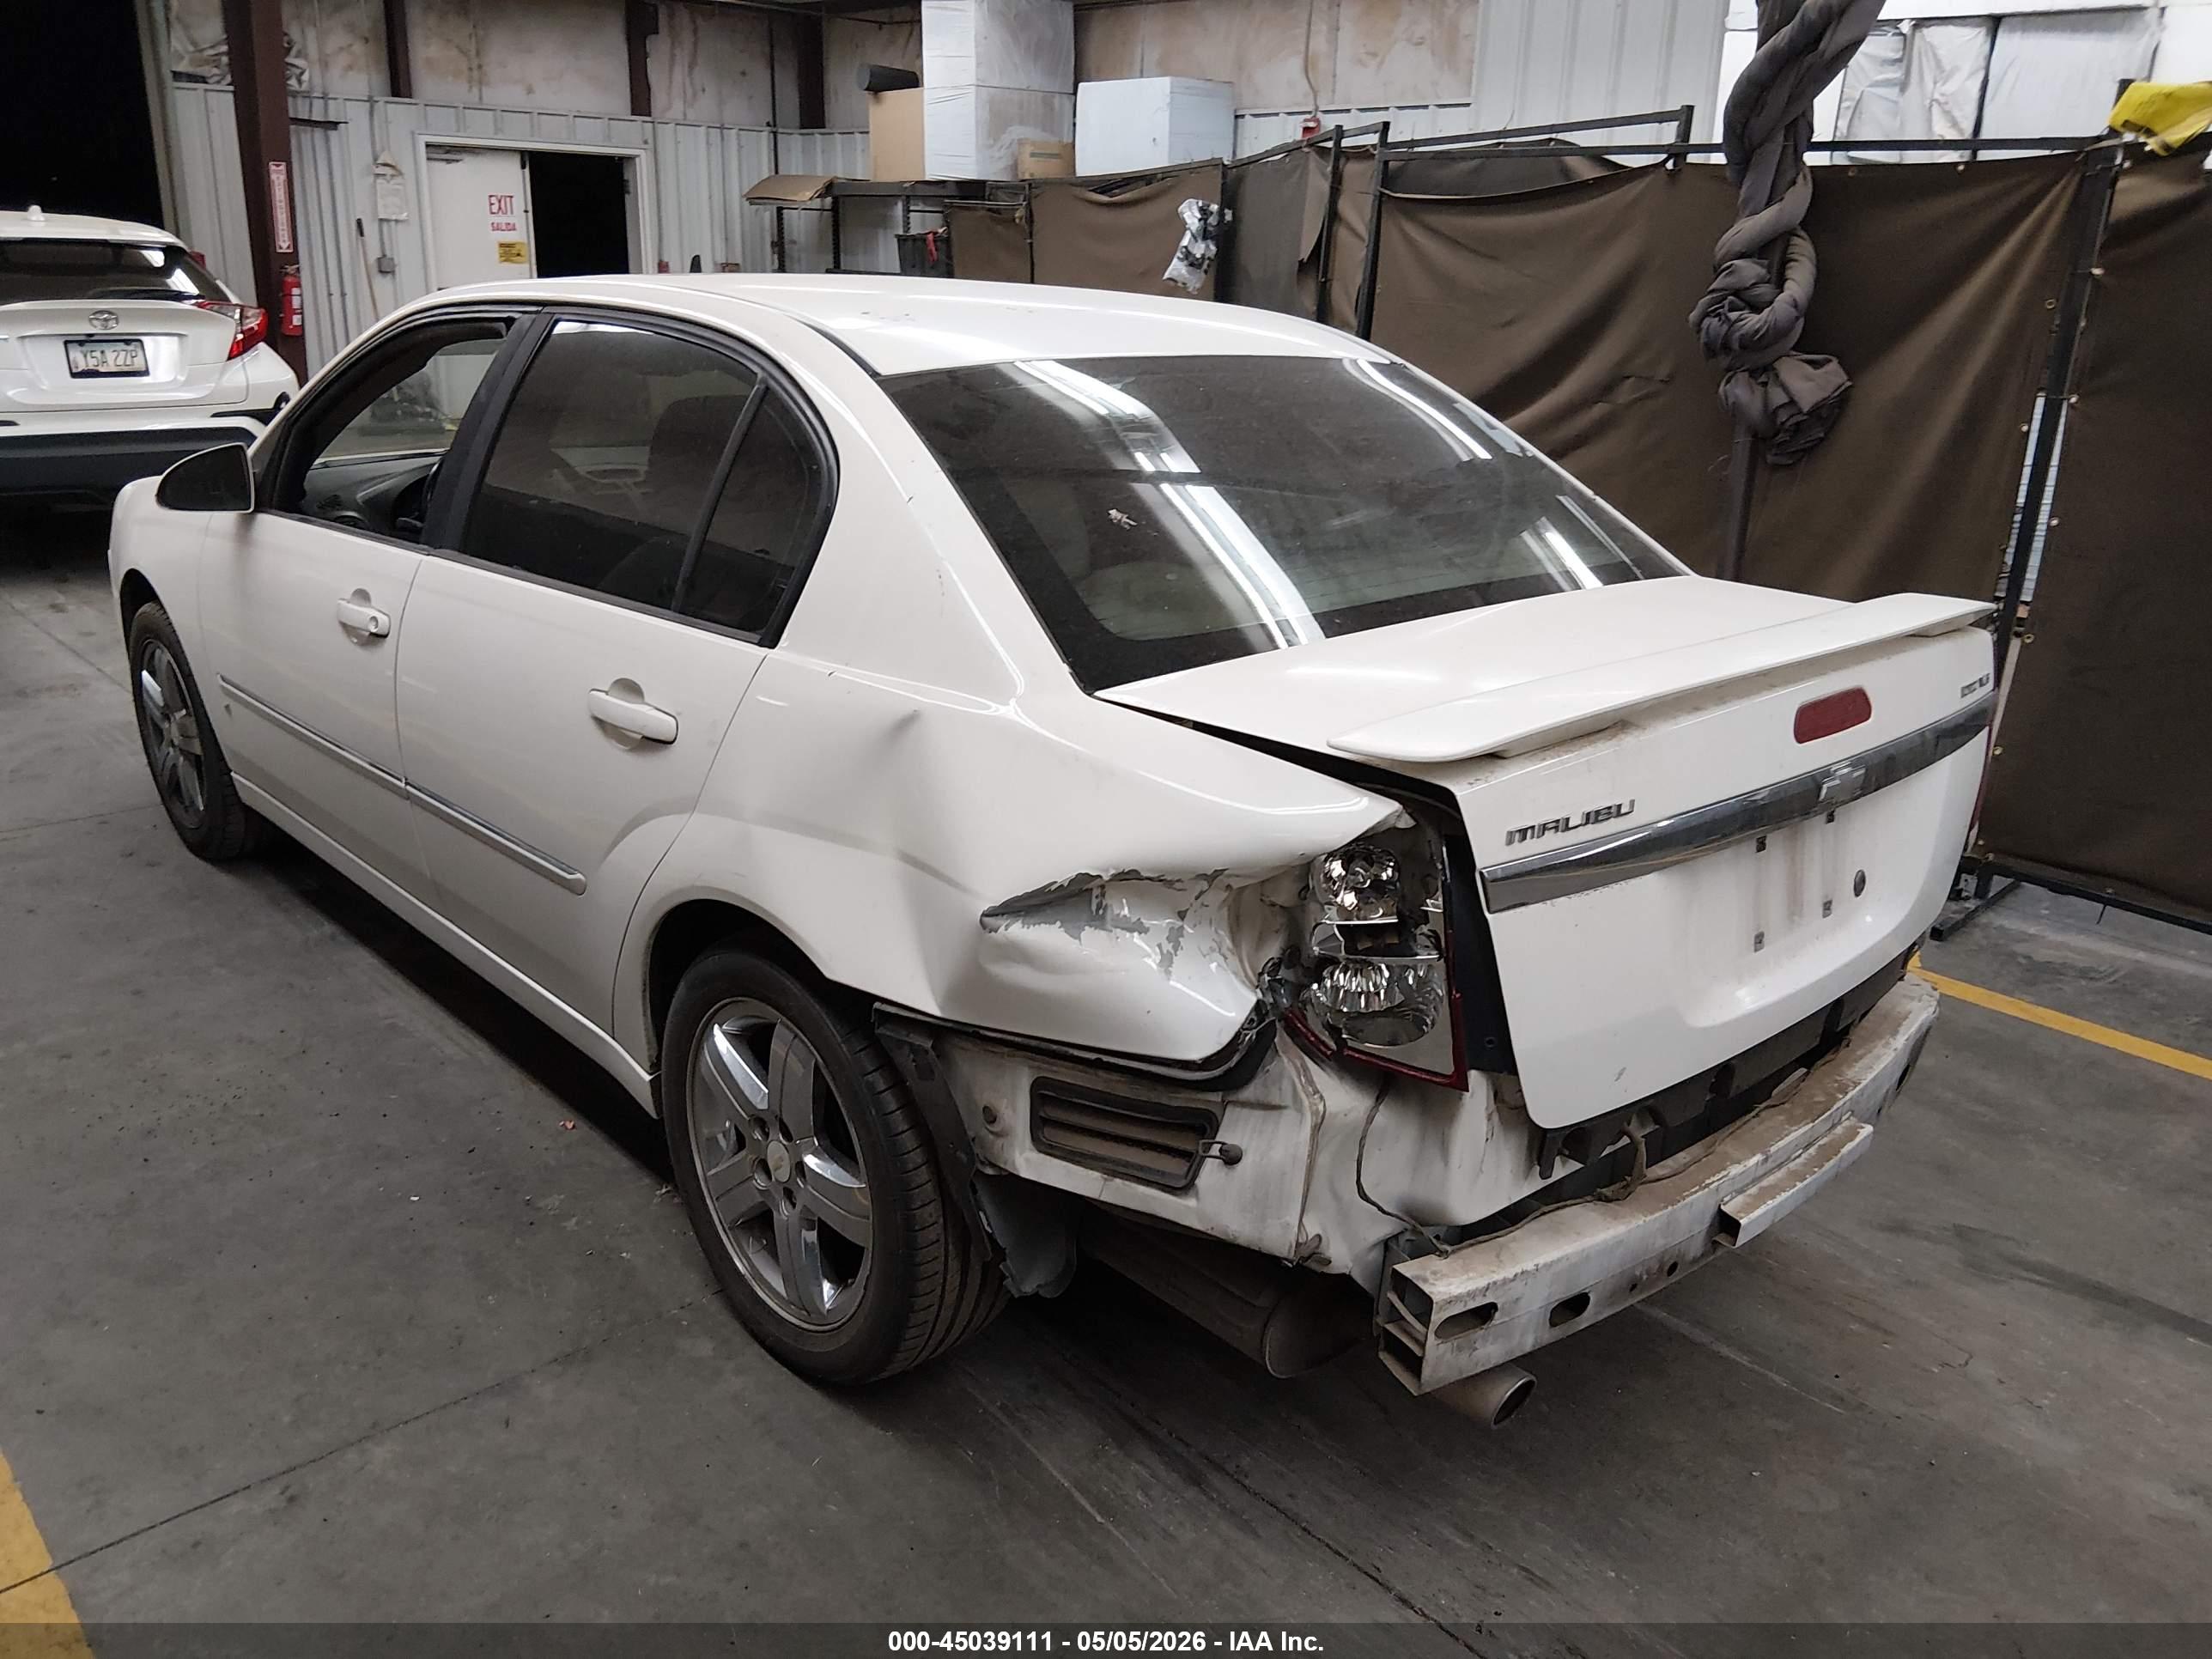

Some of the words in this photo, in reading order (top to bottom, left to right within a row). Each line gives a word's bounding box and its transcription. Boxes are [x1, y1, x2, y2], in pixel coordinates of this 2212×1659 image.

[489, 194, 514, 216] EXIT
[491, 222, 517, 232] SALIDA
[1505, 799, 1636, 847] MALIBU
